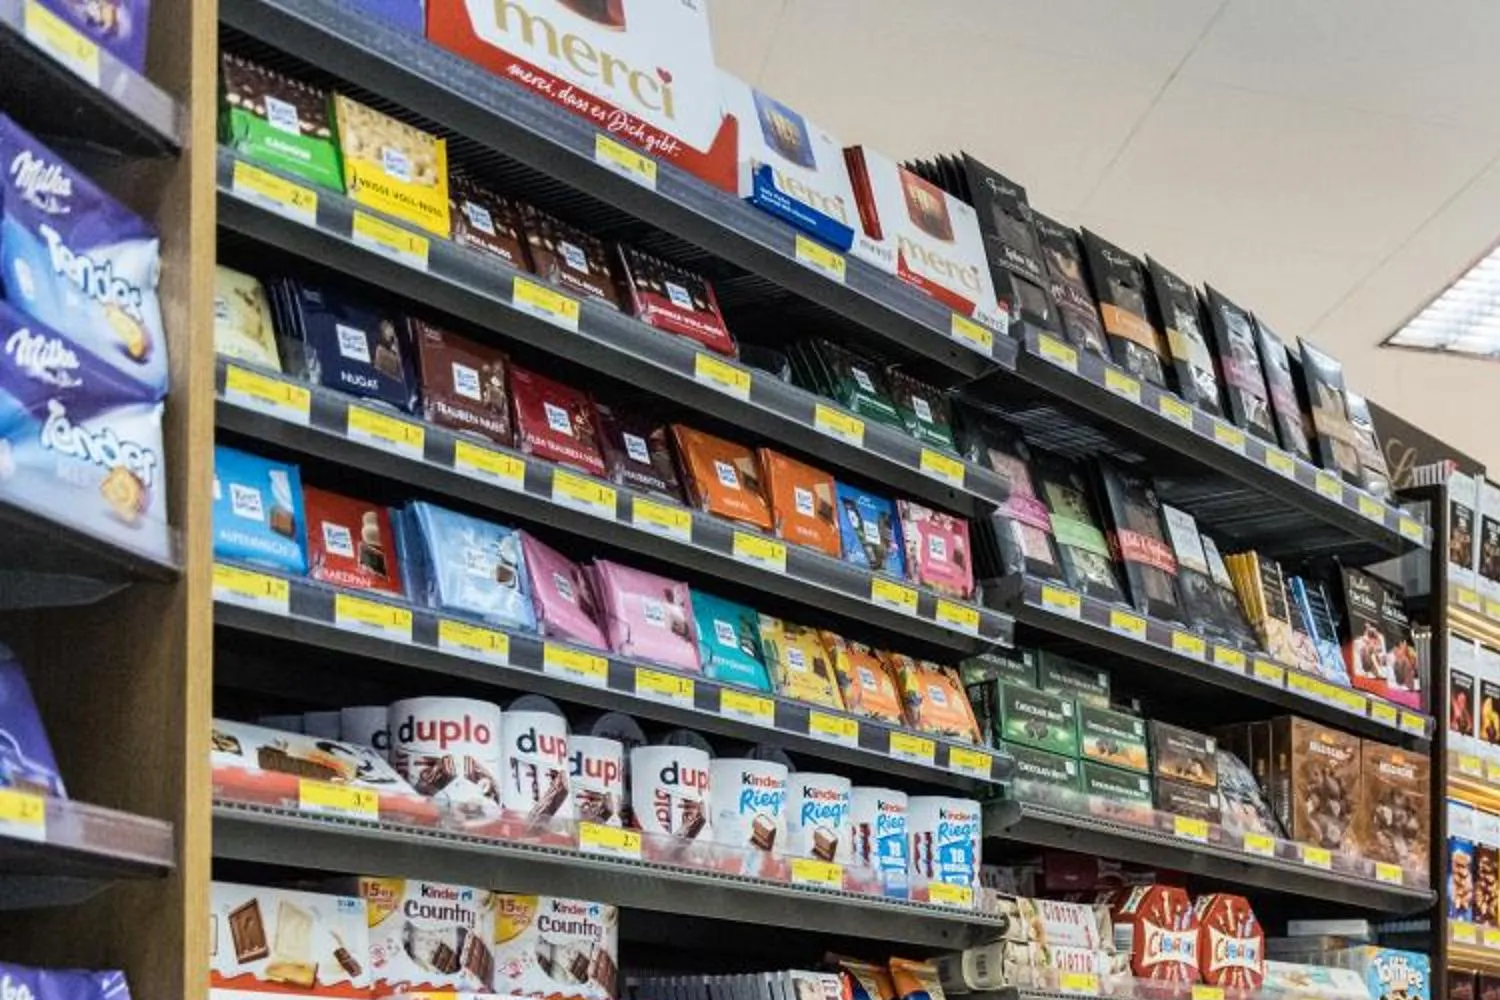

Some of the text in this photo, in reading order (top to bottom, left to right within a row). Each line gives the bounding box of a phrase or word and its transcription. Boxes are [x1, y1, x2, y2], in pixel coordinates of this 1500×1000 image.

[494, 0, 675, 120] merci
[10, 150, 73, 197] Milka
[5, 328, 81, 369] Milka
[42, 397, 156, 488] Tender
[399, 714, 491, 749] duplo
[403, 899, 476, 929] Country
[537, 914, 604, 940] Country
